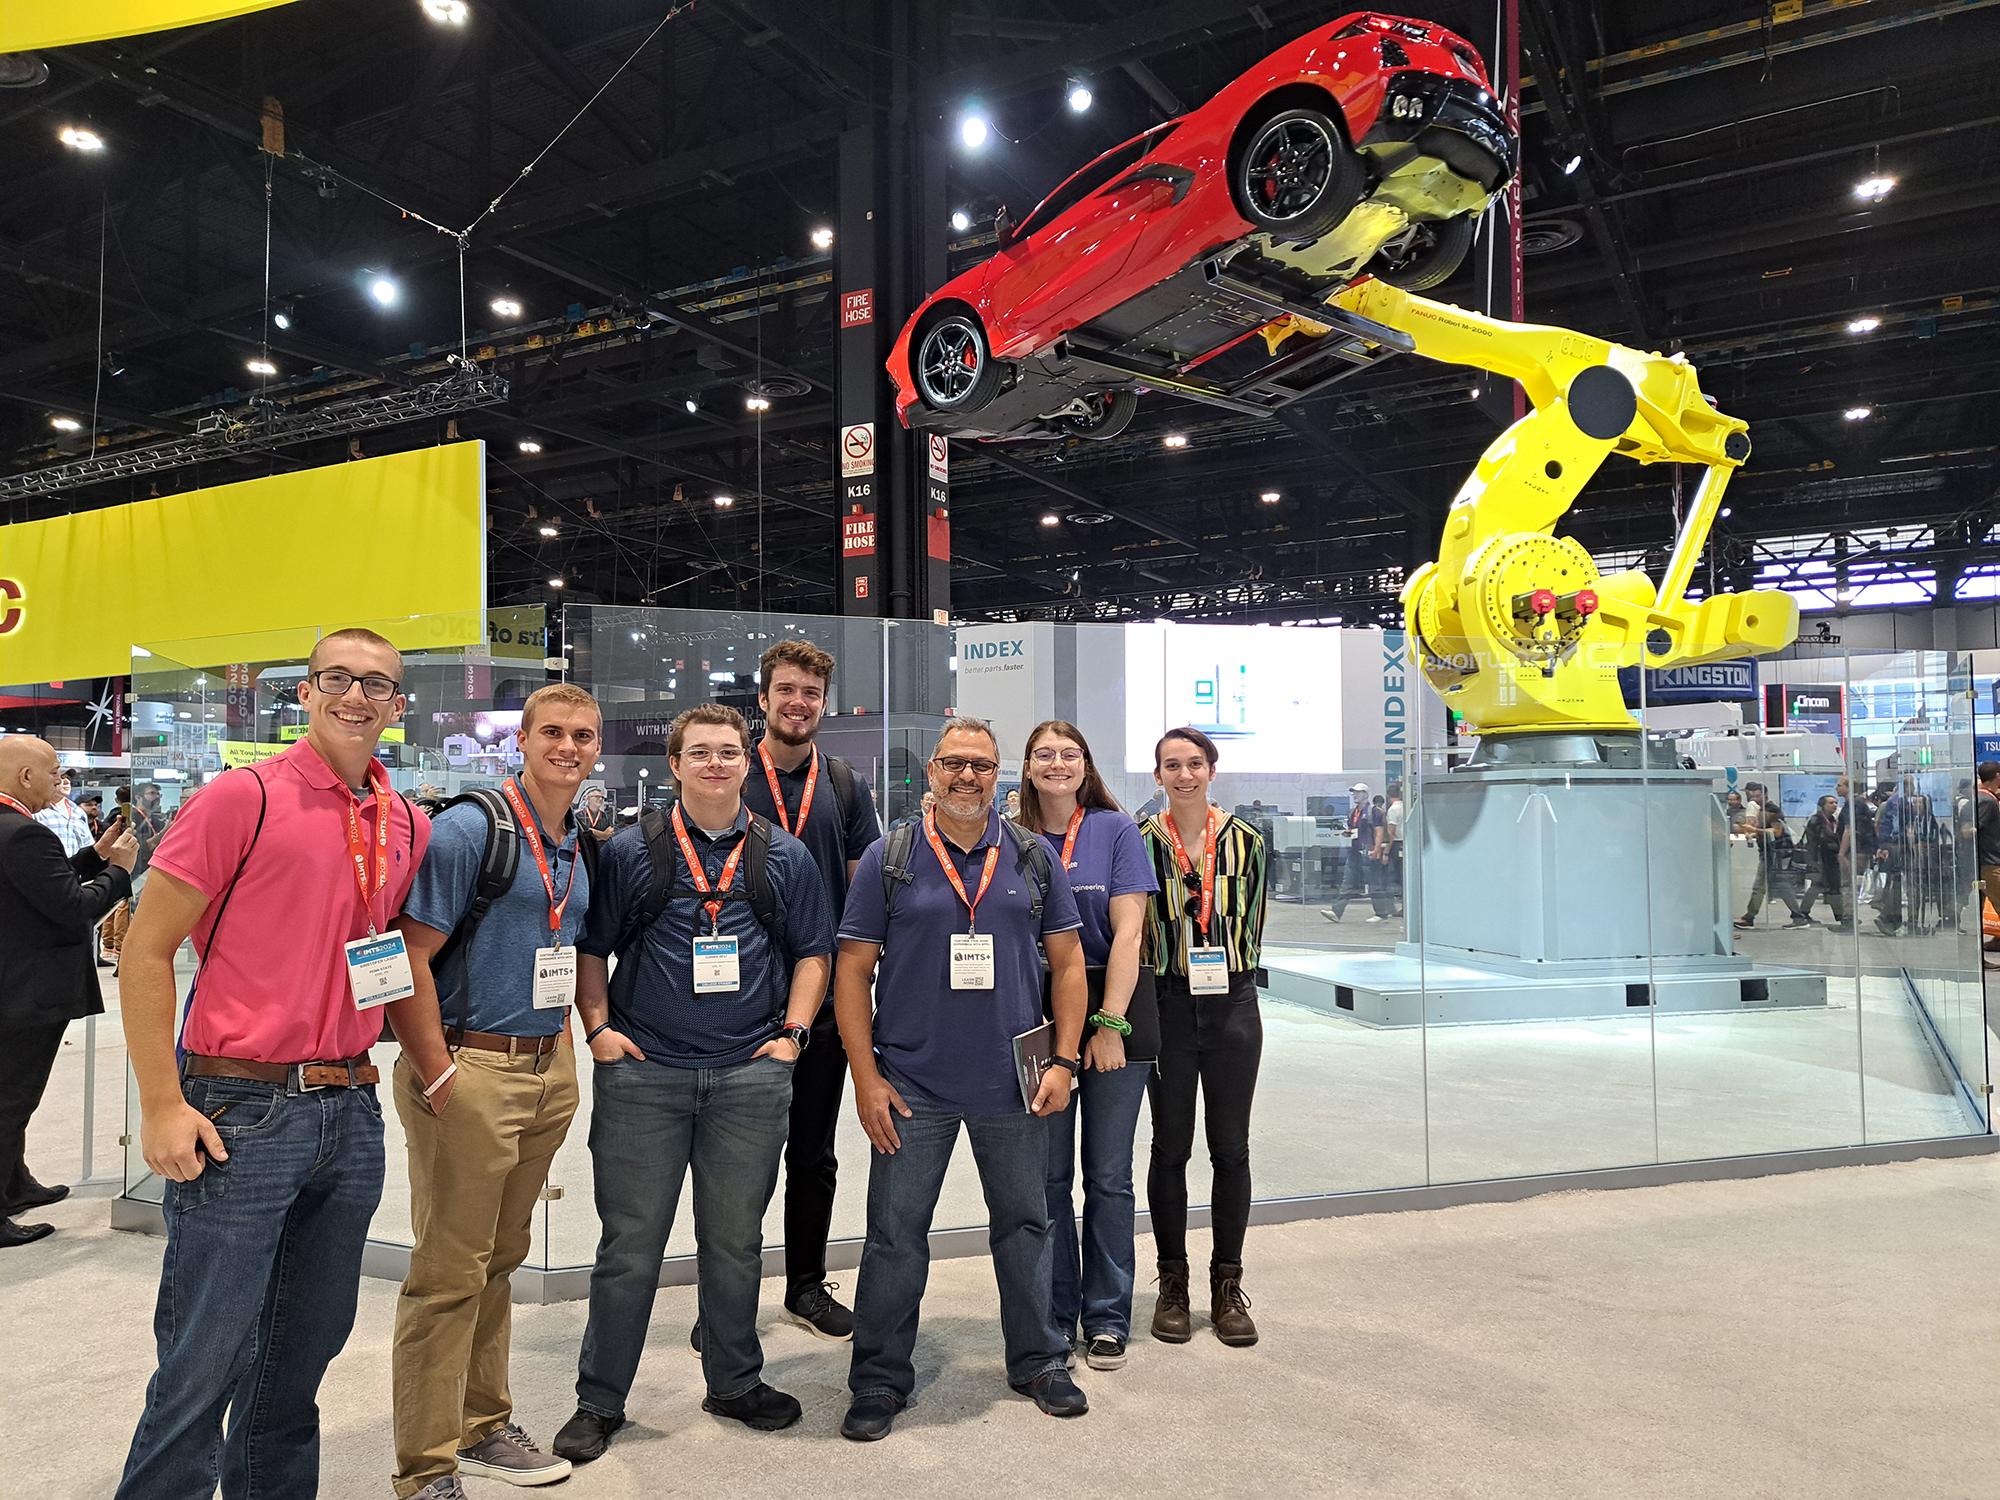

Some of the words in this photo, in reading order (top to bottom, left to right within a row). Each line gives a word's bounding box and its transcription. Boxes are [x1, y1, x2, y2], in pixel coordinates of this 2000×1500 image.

[847, 293, 869, 309] FIRE
[845, 307, 871, 322] HOSE
[1411, 308, 1437, 320] FANUC
[1438, 316, 1461, 328] Robot
[1461, 323, 1493, 337] M-2000
[842, 462, 849, 470] NO
[847, 484, 871, 498] K16
[930, 487, 946, 502] K16
[845, 521, 874, 535] FIRE
[844, 535, 875, 549] HOSE
[964, 639, 1024, 660] INDEX
[1660, 666, 1750, 686] KINGSTON
[1383, 651, 1406, 755] INDEX
[636, 724, 662, 736] WITH
[349, 805, 360, 844] IMTS2024
[379, 801, 388, 839] IMTS2024
[528, 832, 543, 865] IMTS2024
[1070, 883, 1106, 892] ngineering
[363, 942, 397, 956] IMTS2024
[964, 953, 991, 961] IMTS+
[548, 967, 574, 977] IMTS+
